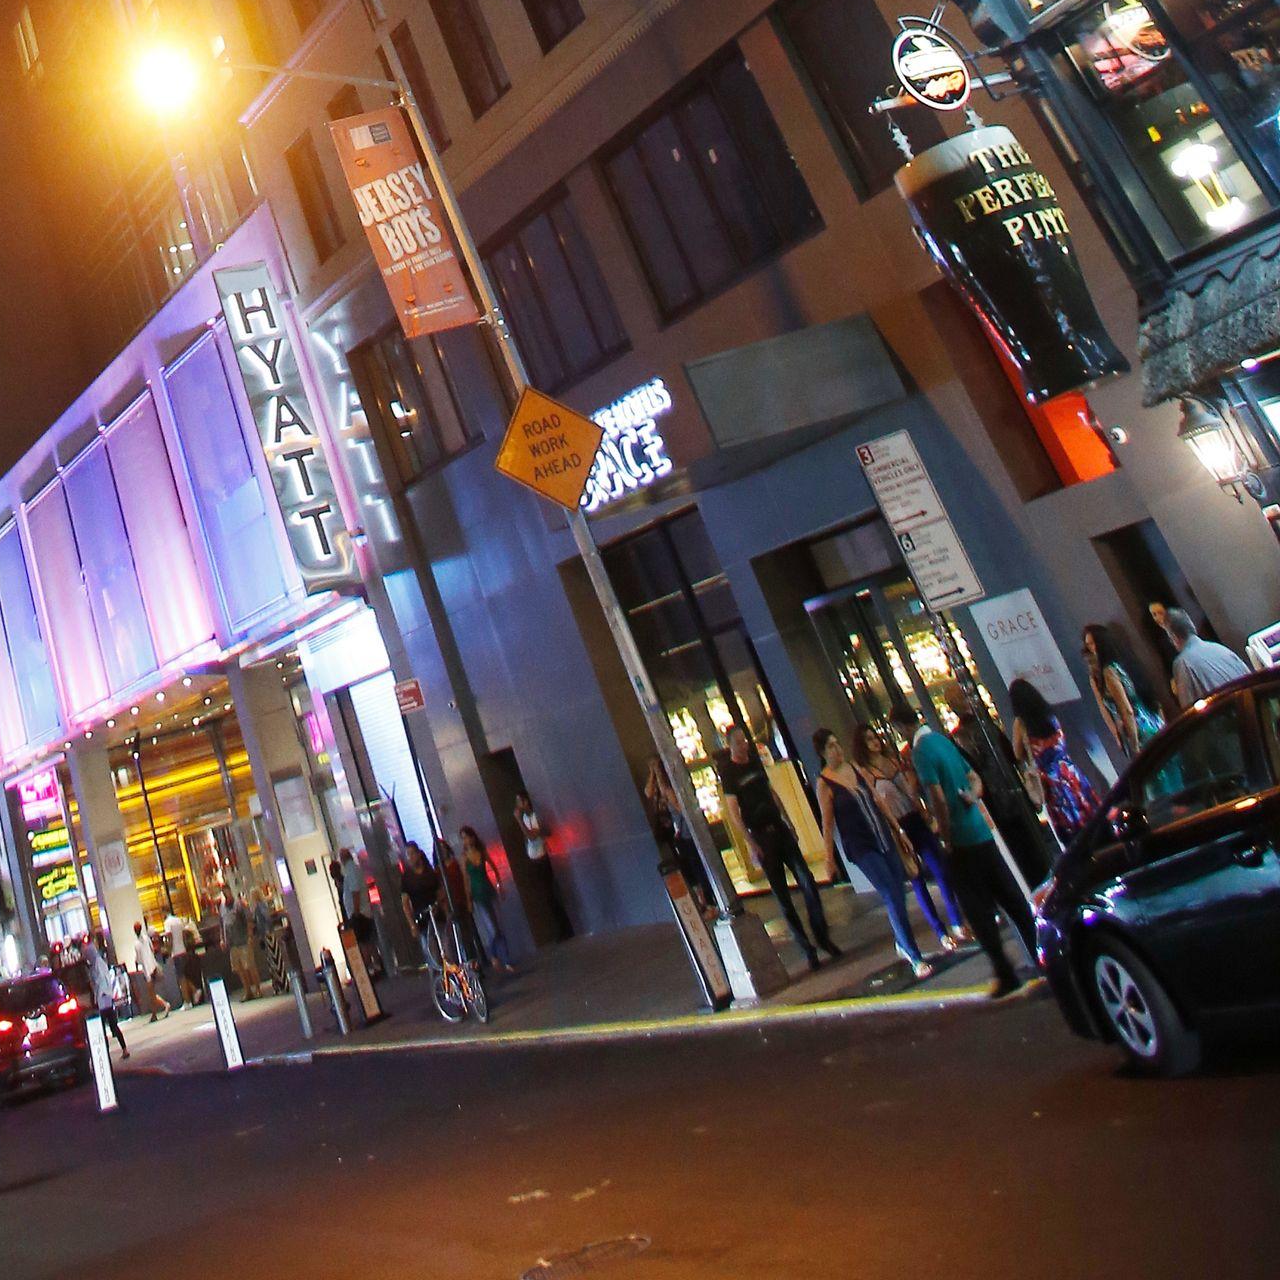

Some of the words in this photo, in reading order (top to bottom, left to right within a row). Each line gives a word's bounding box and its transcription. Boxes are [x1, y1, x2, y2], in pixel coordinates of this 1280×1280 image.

[970, 142, 1033, 174] THE
[352, 161, 433, 227] JERSEY
[376, 203, 442, 262] BOYS
[1002, 206, 1071, 247] PINT
[232, 285, 333, 557] HYATT
[522, 413, 562, 439] ROAD
[527, 433, 568, 458] WORK
[533, 453, 582, 482] AHEAD
[987, 611, 1039, 640] GRACE
